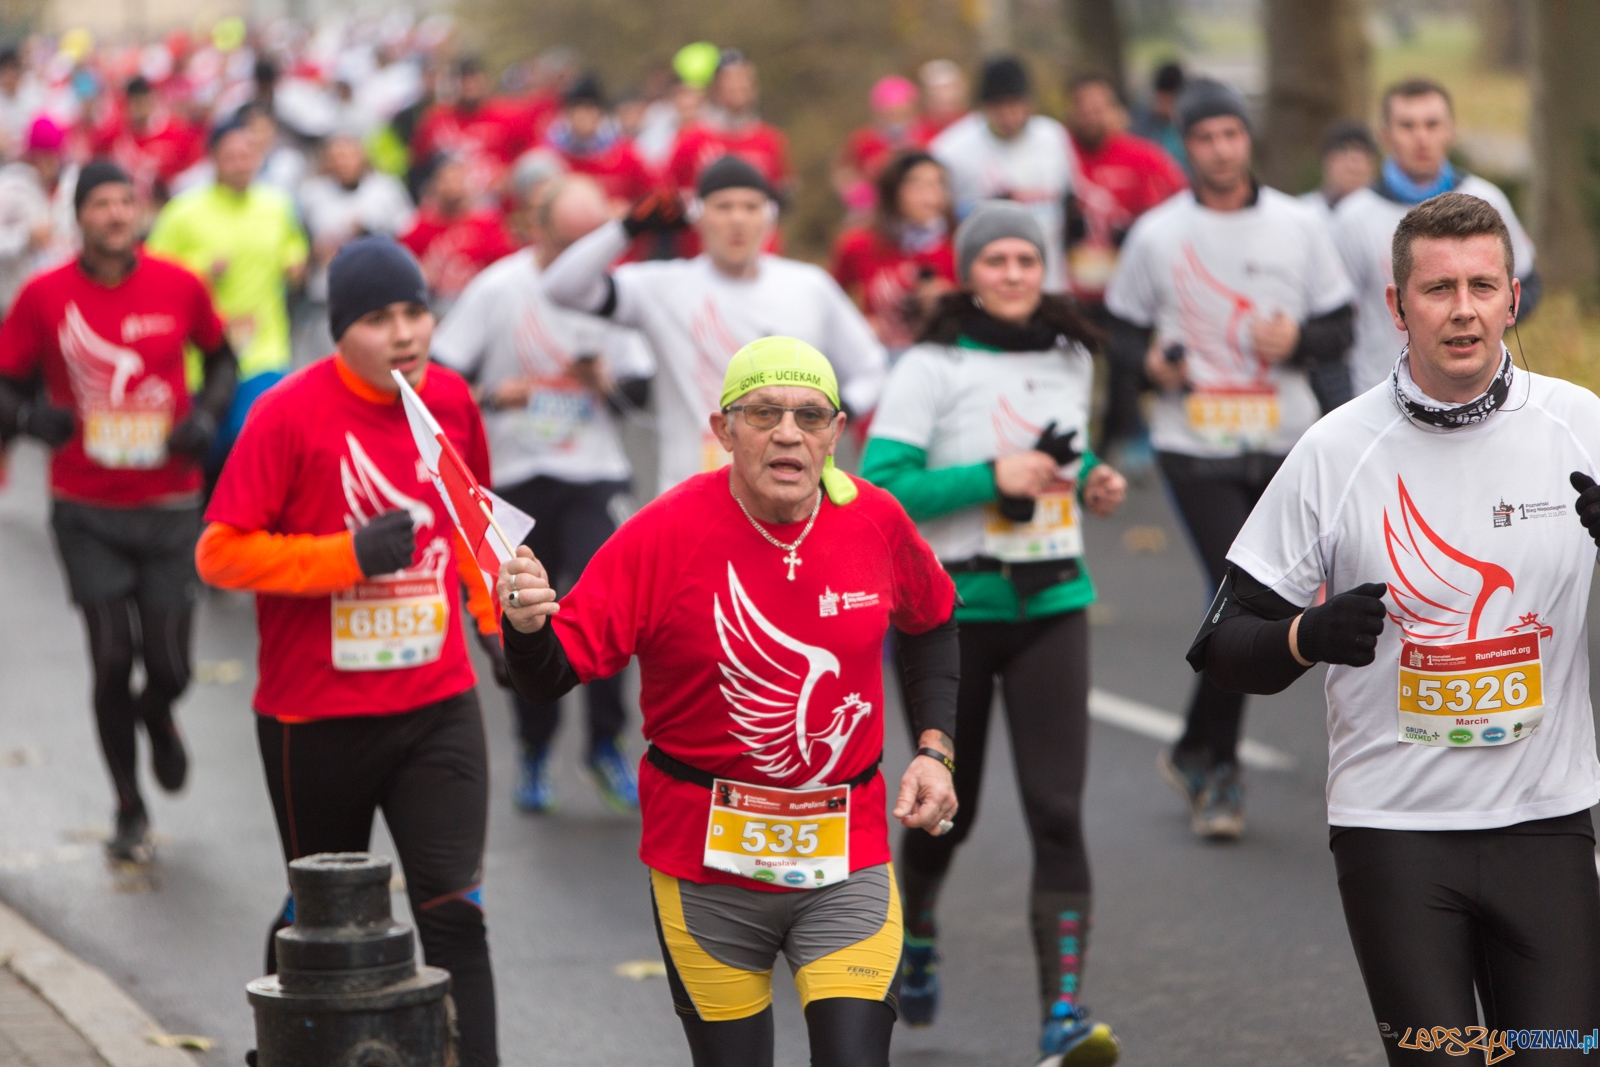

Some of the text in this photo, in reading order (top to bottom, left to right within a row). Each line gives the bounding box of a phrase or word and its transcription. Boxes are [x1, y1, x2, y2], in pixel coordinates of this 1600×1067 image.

[740, 372, 765, 391] GONIĘ
[775, 370, 821, 386] UCIEKAM
[1518, 503, 1528, 520] 1
[349, 604, 435, 638] 6852
[1475, 646, 1531, 660] RunPoland.org
[1402, 671, 1528, 712] D 5326
[1456, 718, 1489, 726] Marcin
[1406, 726, 1428, 735] GRUPA
[1406, 733, 1432, 742] LUXMED
[712, 820, 819, 854] D 535
[847, 966, 879, 976] FEROTI
